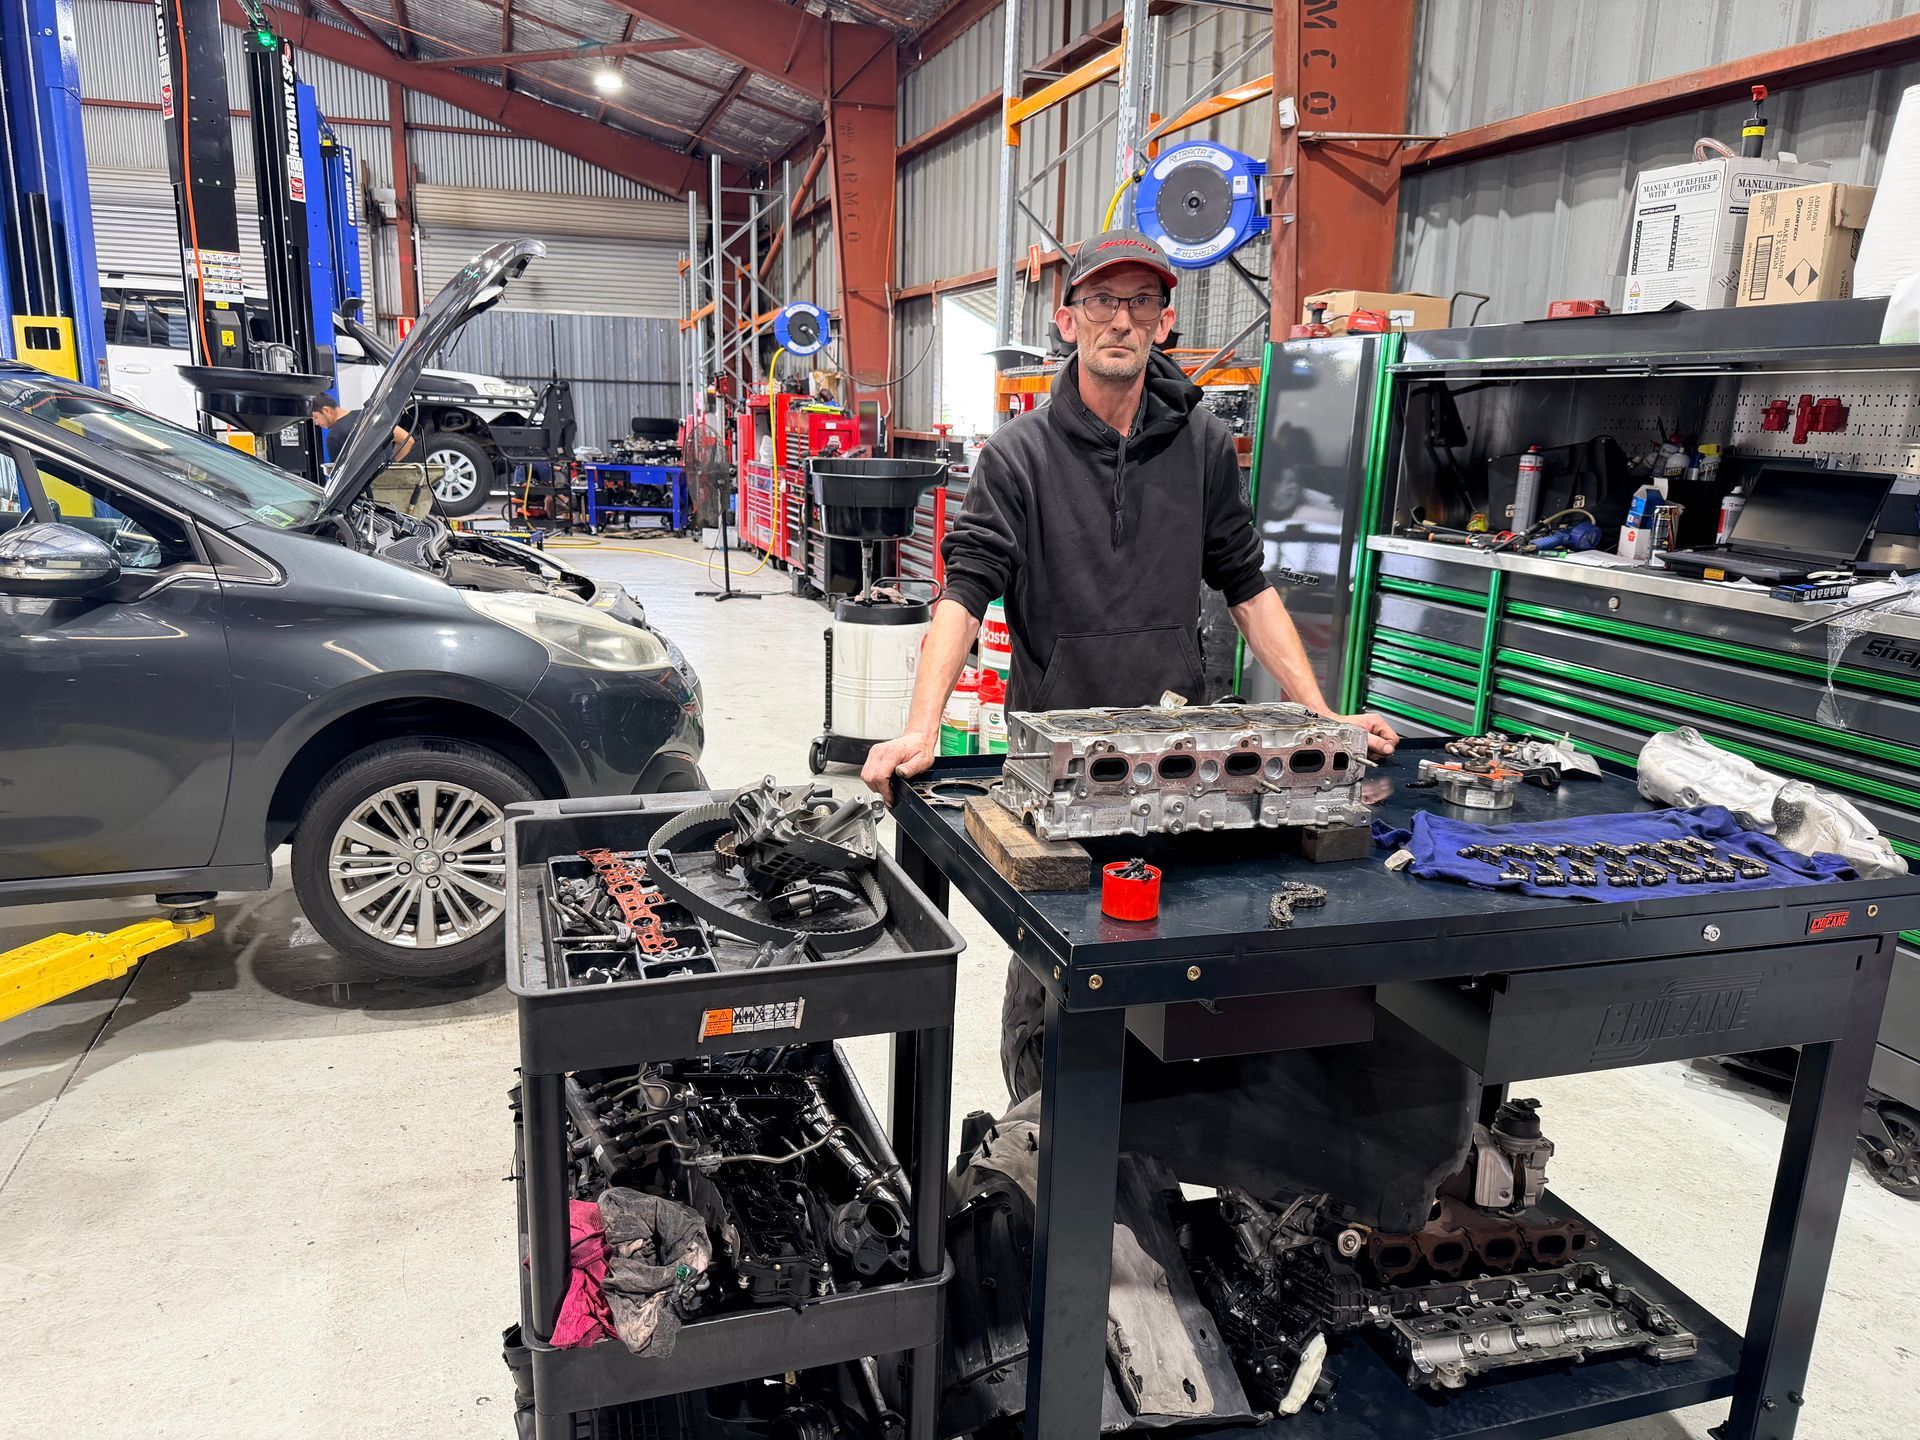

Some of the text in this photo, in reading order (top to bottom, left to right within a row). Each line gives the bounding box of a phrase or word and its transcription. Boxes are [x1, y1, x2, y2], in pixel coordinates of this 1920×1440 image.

[284, 86, 300, 157] ROTARY
[1168, 148, 1207, 164] RETRACTA
[342, 148, 356, 221] ROTARY LIFT
[1643, 174, 1718, 193] MANUAL ATF REFILLER
[1648, 190, 1667, 199] WITH
[1676, 183, 1711, 195] ADAPTERS
[1737, 179, 1773, 190] MANUAL
[841, 154, 861, 243] ARMCO
[1806, 195, 1814, 221] UN1950
[1811, 195, 1820, 232] AEROSOLS
[1776, 230, 1783, 238] 12
[1776, 218, 1791, 280] BRAKE CLEANER
[1810, 914, 1849, 931] CHICANE
[1596, 987, 1759, 1046] CHICANE
